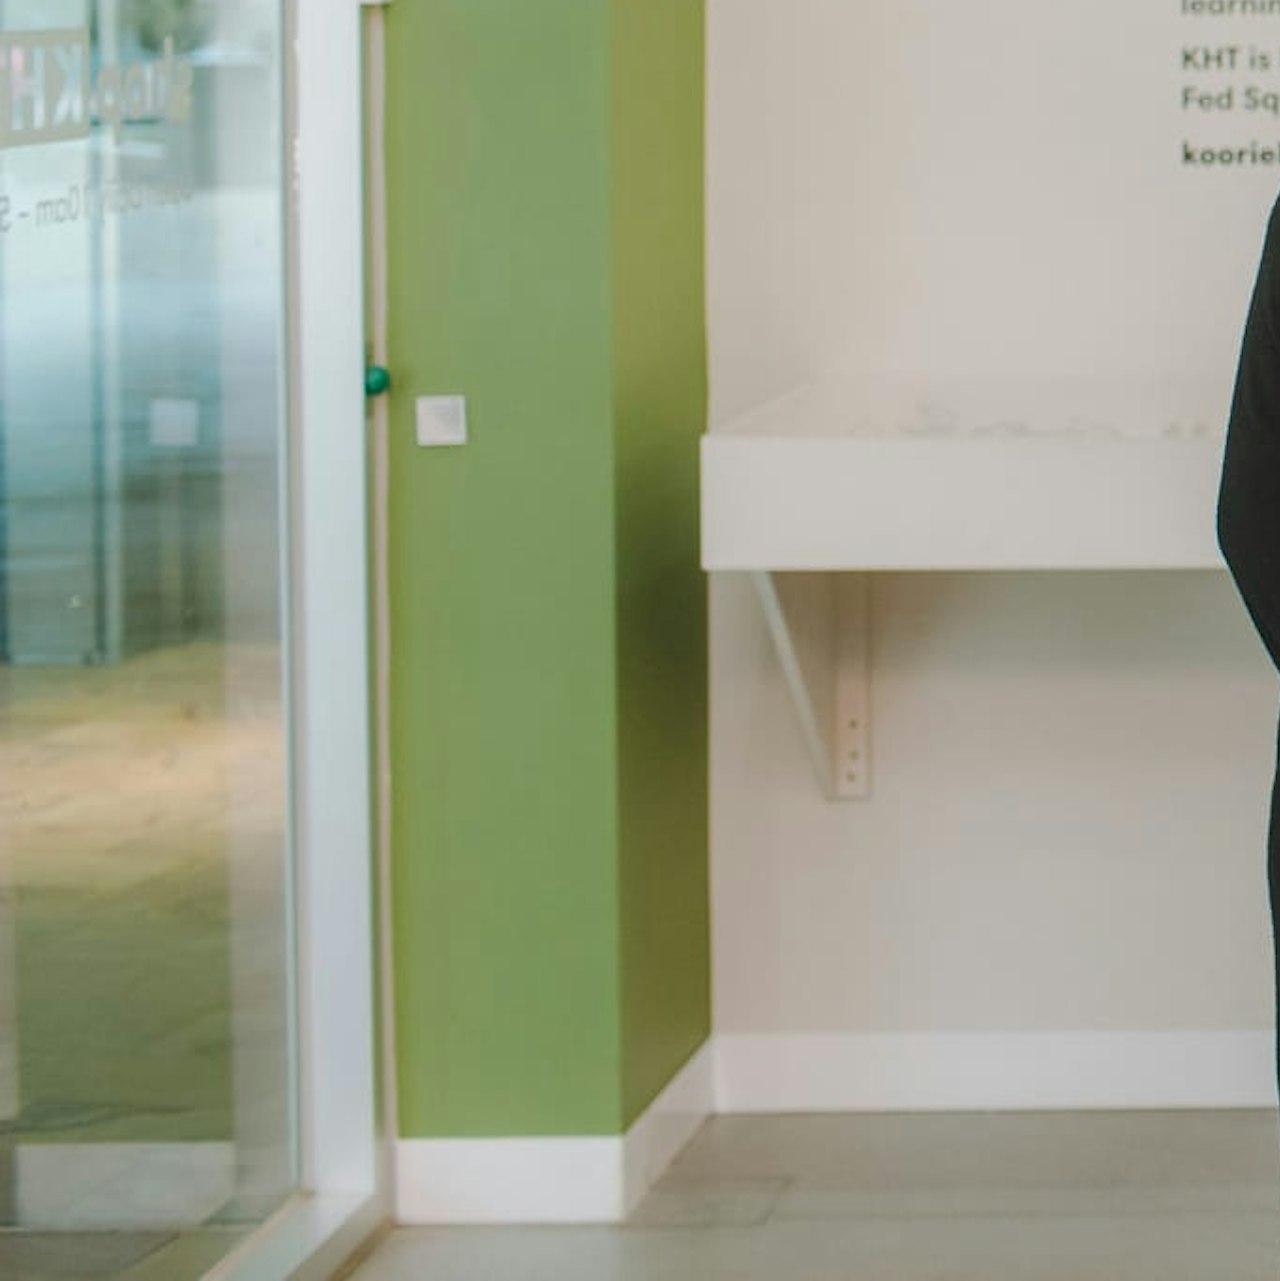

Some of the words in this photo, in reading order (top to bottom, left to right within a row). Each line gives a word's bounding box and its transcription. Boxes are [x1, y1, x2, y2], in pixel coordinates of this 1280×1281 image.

[1182, 47, 1237, 70] KHT
[1250, 49, 1269, 70] is
[1182, 87, 1233, 111] Fed
